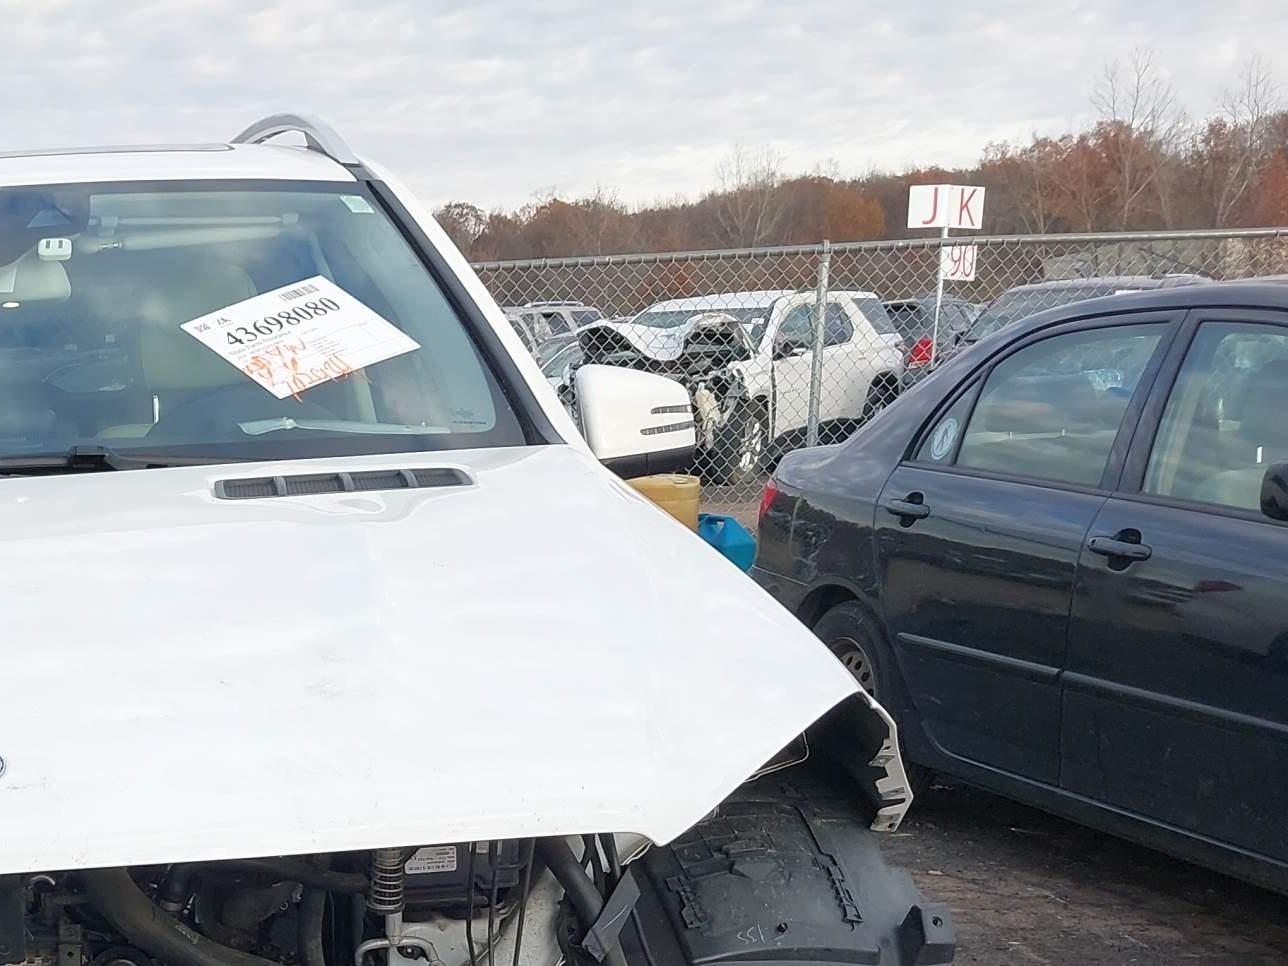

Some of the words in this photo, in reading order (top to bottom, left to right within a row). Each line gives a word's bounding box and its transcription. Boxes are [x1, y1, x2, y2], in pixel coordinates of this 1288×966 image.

[921, 187, 939, 225] J
[958, 187, 977, 226] K
[950, 245, 975, 278] 90
[226, 297, 341, 346] 43698080
